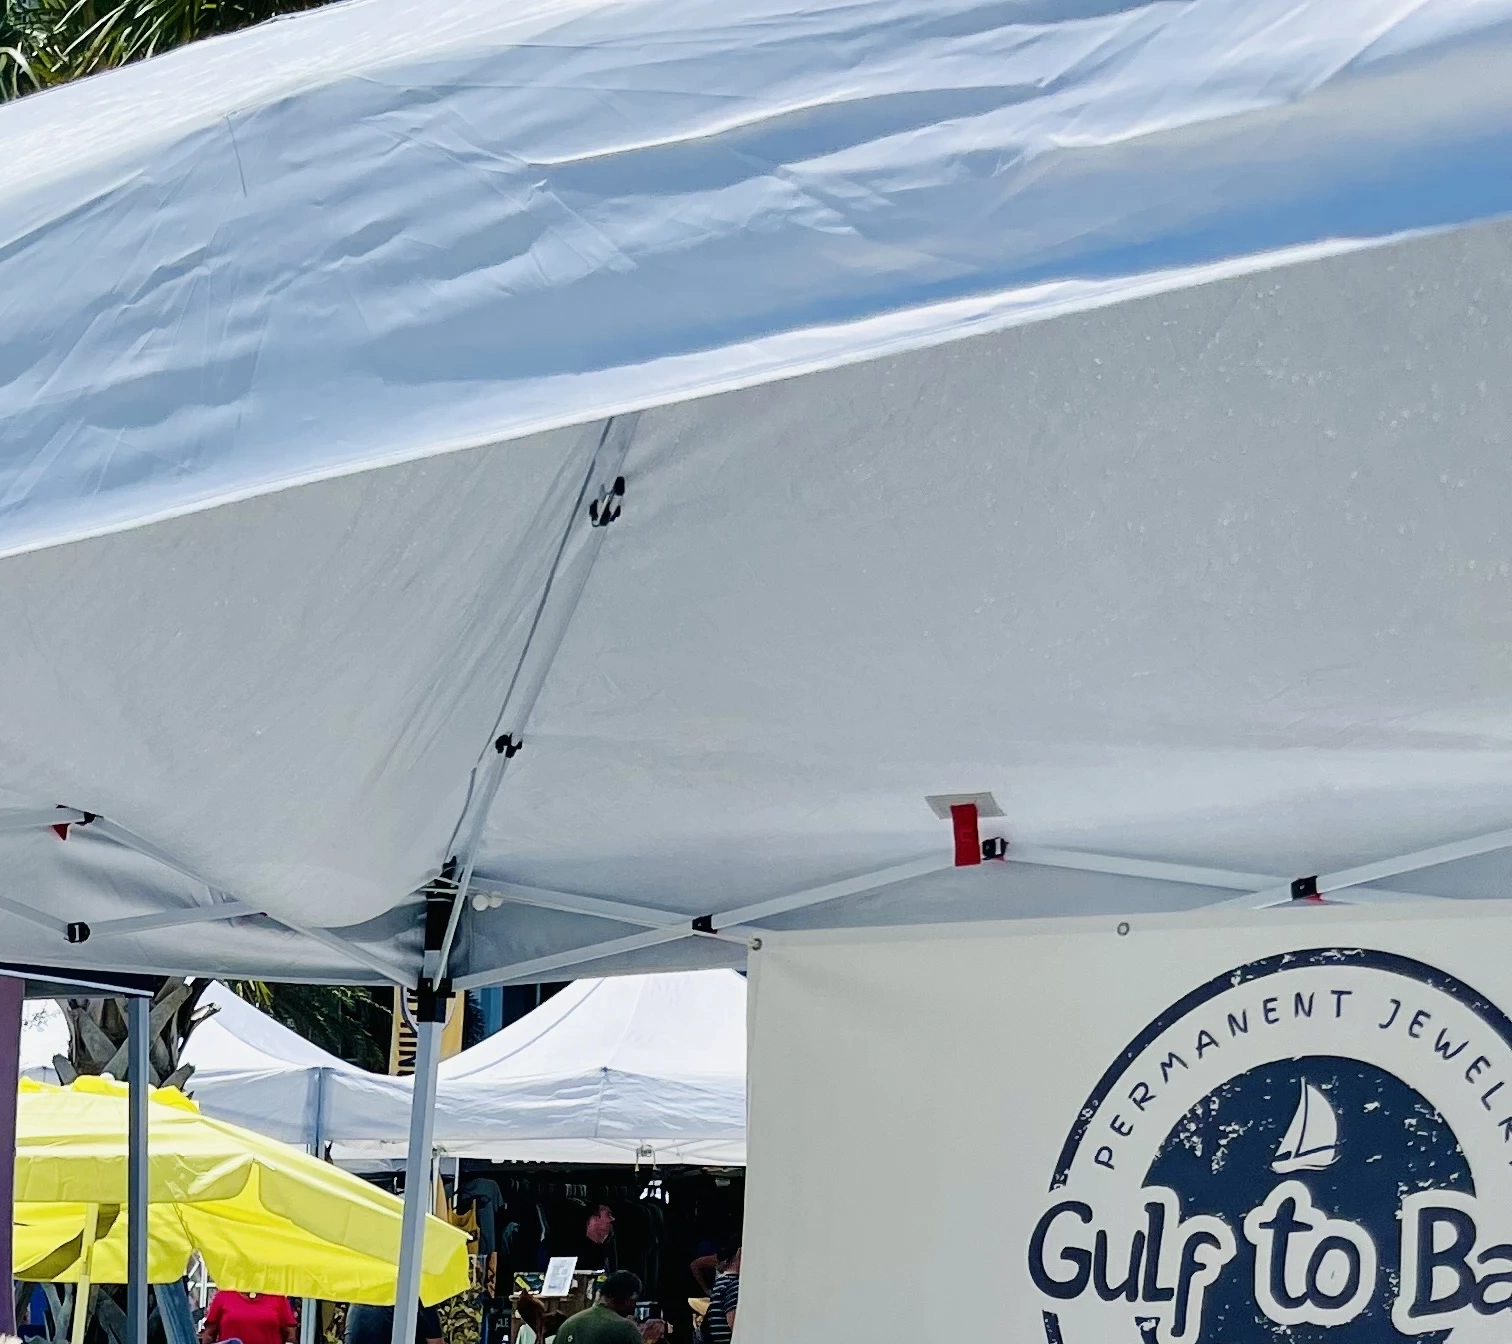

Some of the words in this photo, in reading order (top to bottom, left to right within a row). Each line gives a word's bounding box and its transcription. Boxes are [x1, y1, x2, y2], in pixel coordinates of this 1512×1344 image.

[1094, 990, 1352, 1170] PERMANENT
[1379, 998, 1512, 1167] JEWEL
[1028, 1201, 1221, 1337] Gulf
[1259, 1196, 1361, 1310] to
